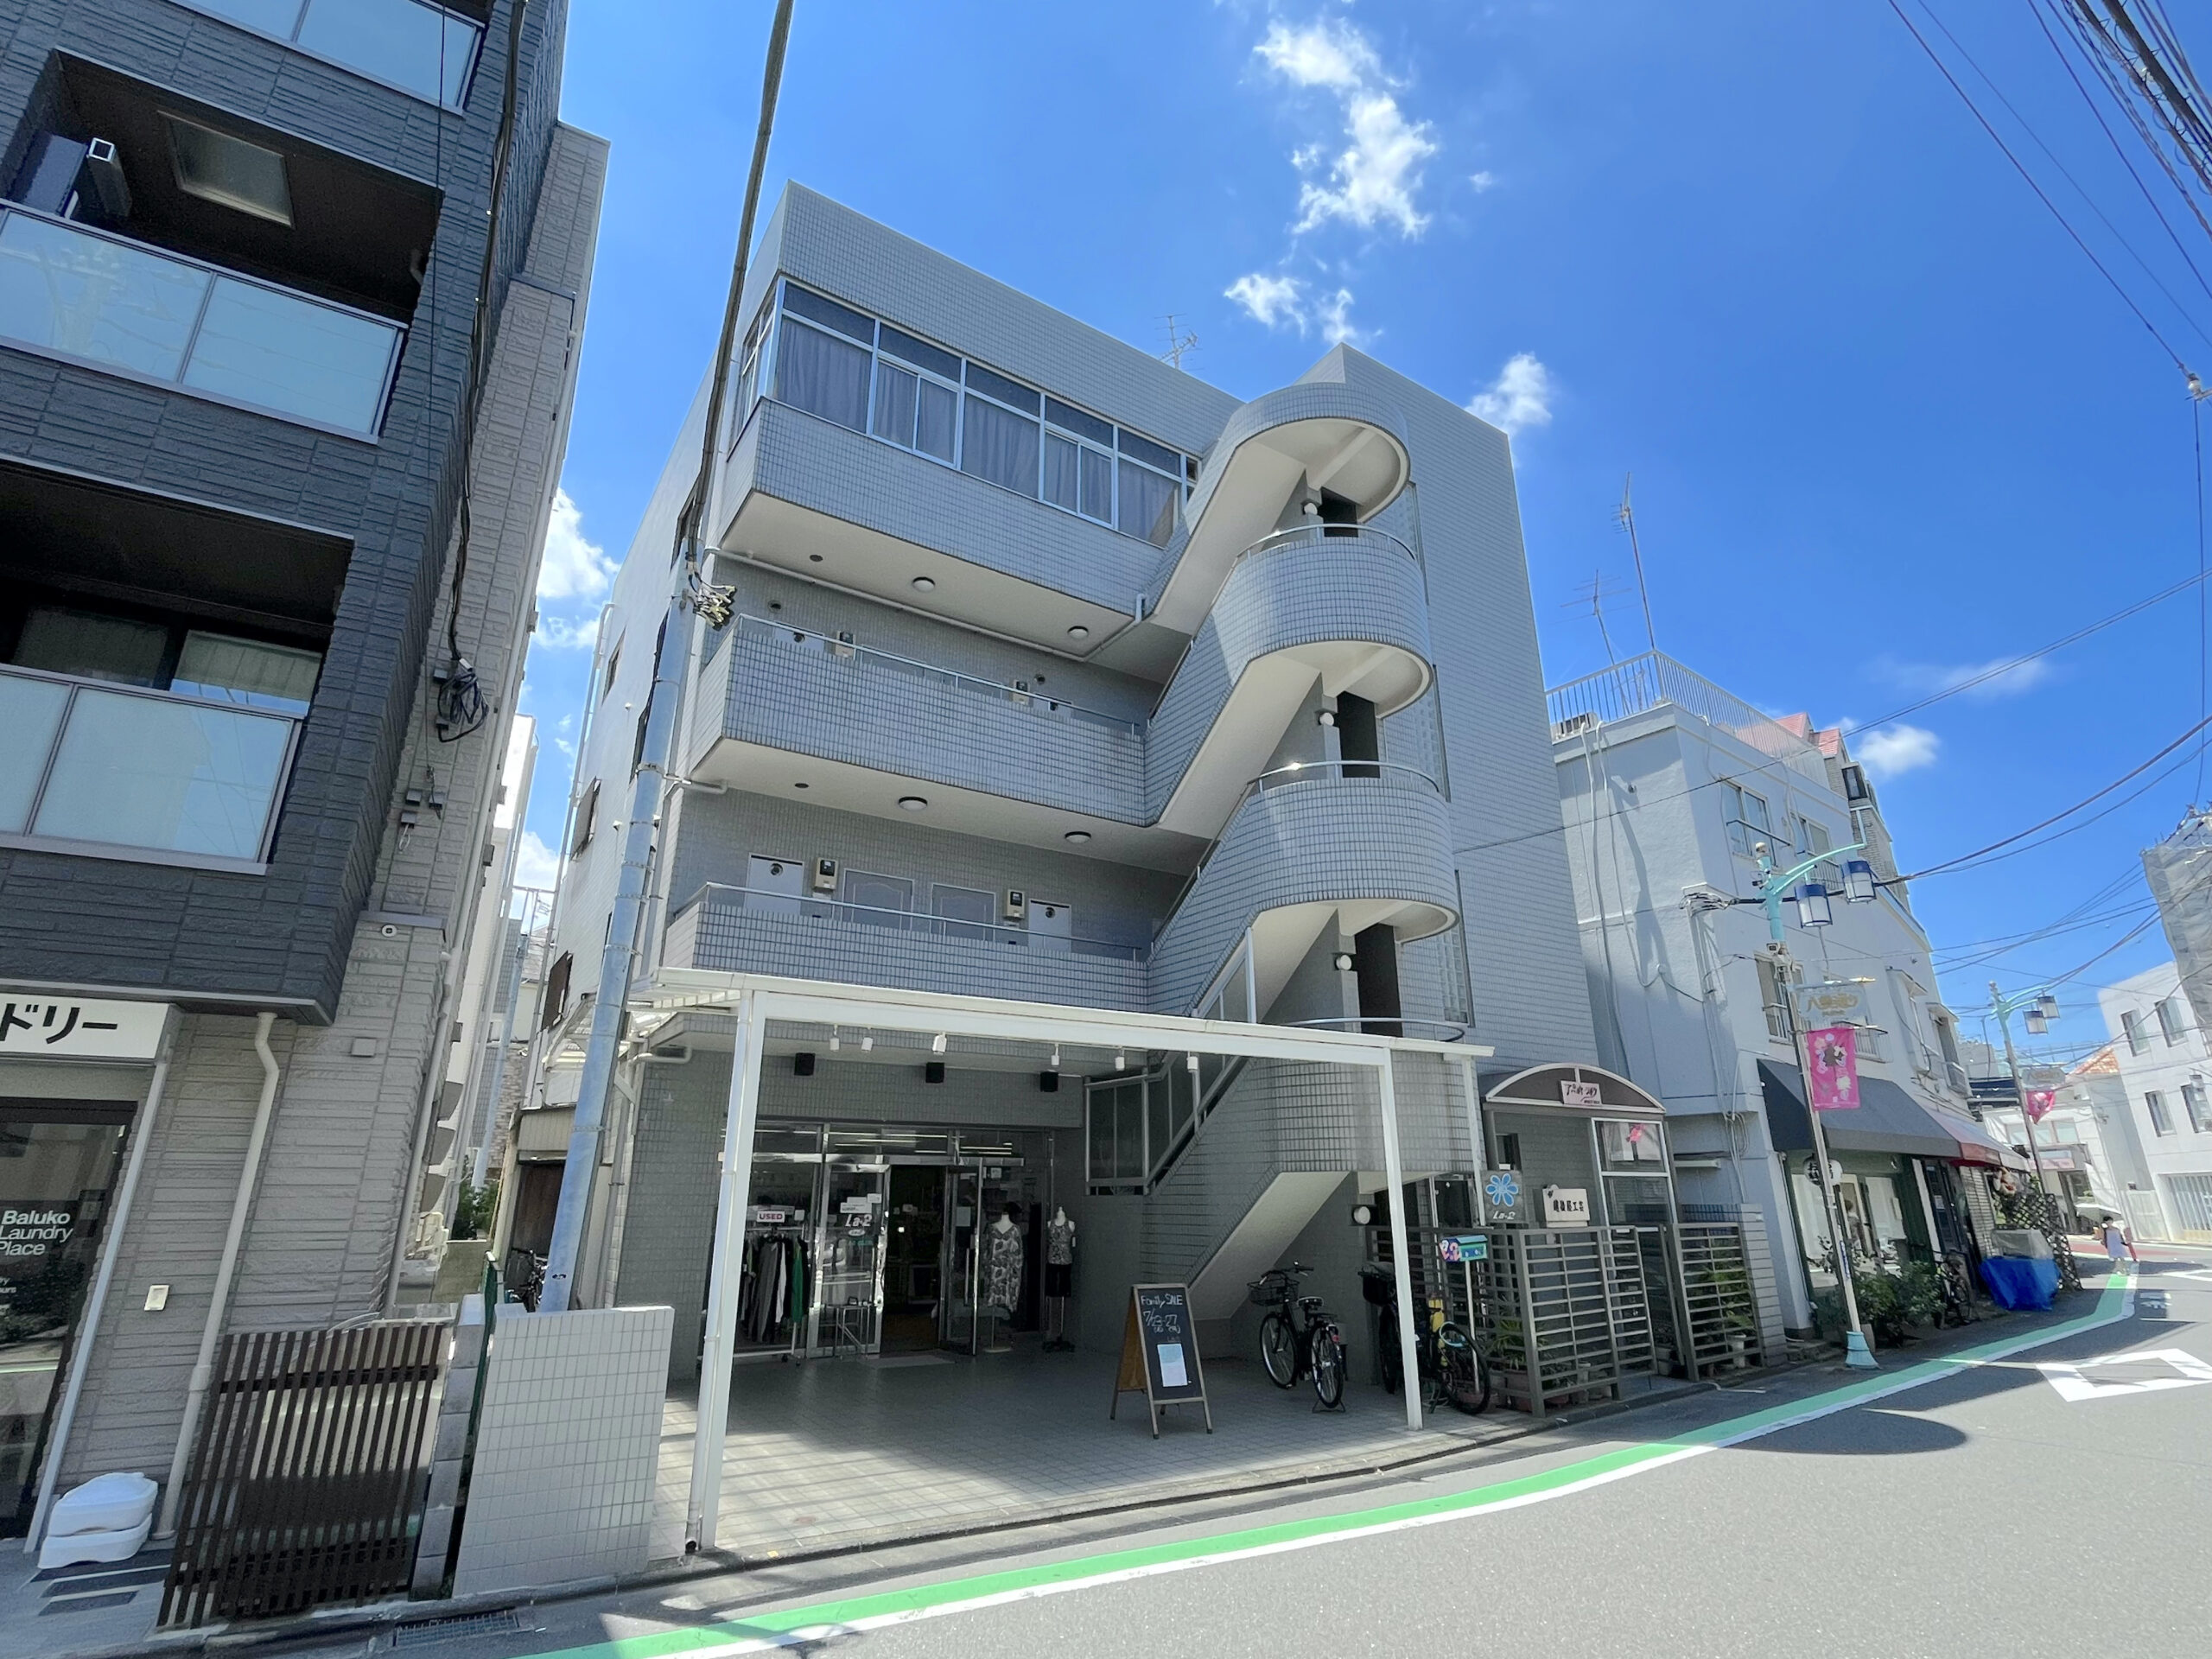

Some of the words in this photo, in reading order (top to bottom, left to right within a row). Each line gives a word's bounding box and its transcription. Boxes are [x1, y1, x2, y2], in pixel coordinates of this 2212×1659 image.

[0, 1003, 118, 1044] ドリー
[2, 1210, 71, 1225] Baluko
[0, 1224, 73, 1243] Laundry
